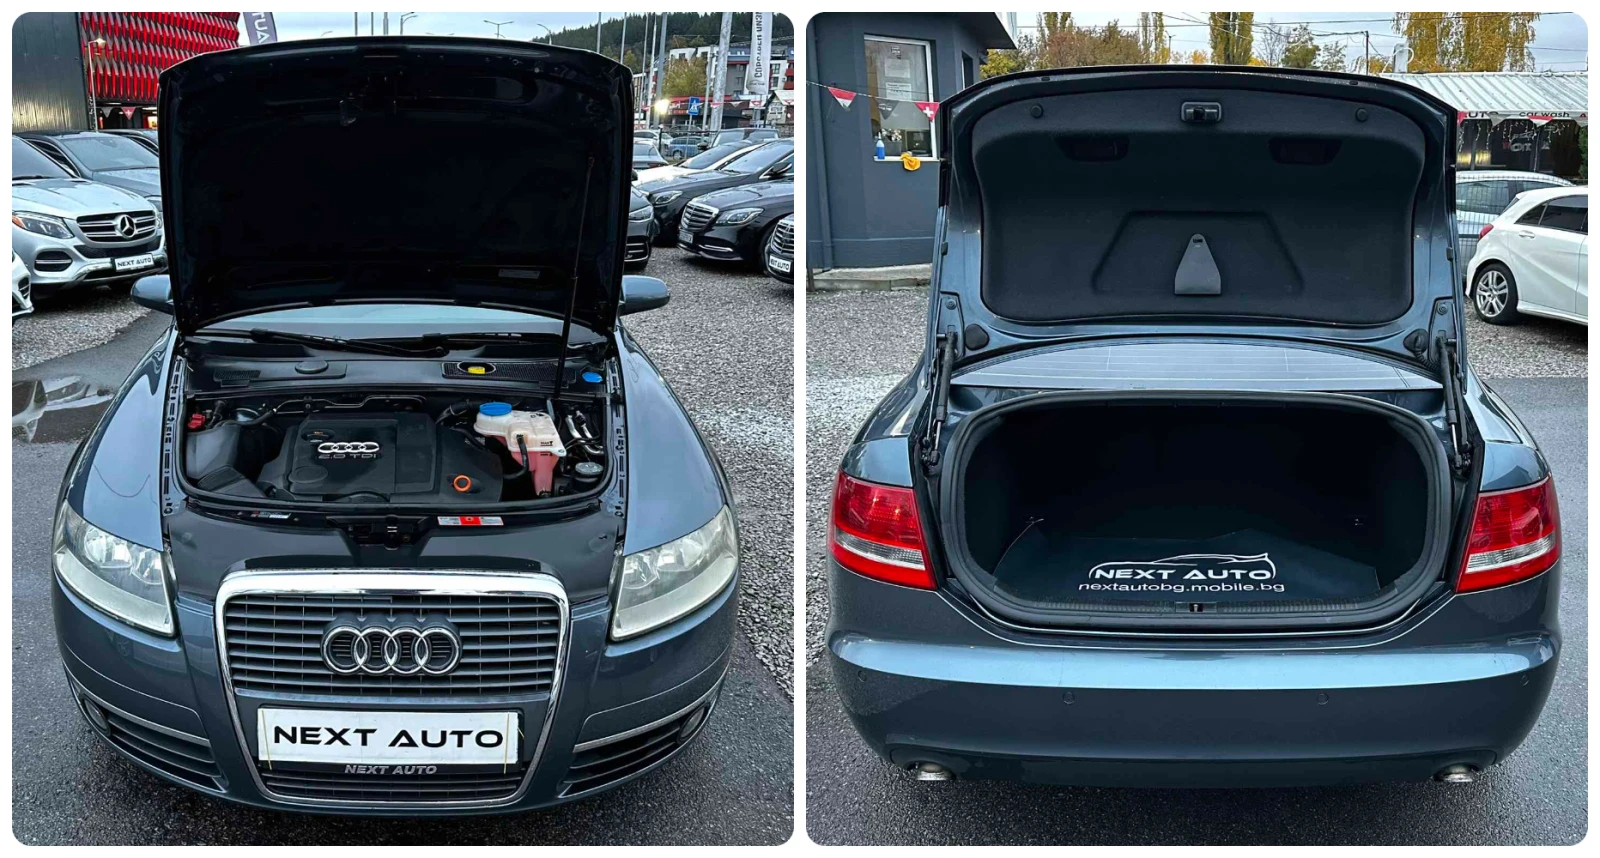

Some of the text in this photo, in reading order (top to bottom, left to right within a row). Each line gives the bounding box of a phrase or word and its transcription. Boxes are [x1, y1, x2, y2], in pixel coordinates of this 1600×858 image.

[1094, 569, 1272, 580] NEXT AUTO
[1078, 582, 1285, 593] nextautobg.mobile.bg
[274, 725, 504, 748] NEXT AUTO
[344, 764, 438, 775] NEXT AUTO
